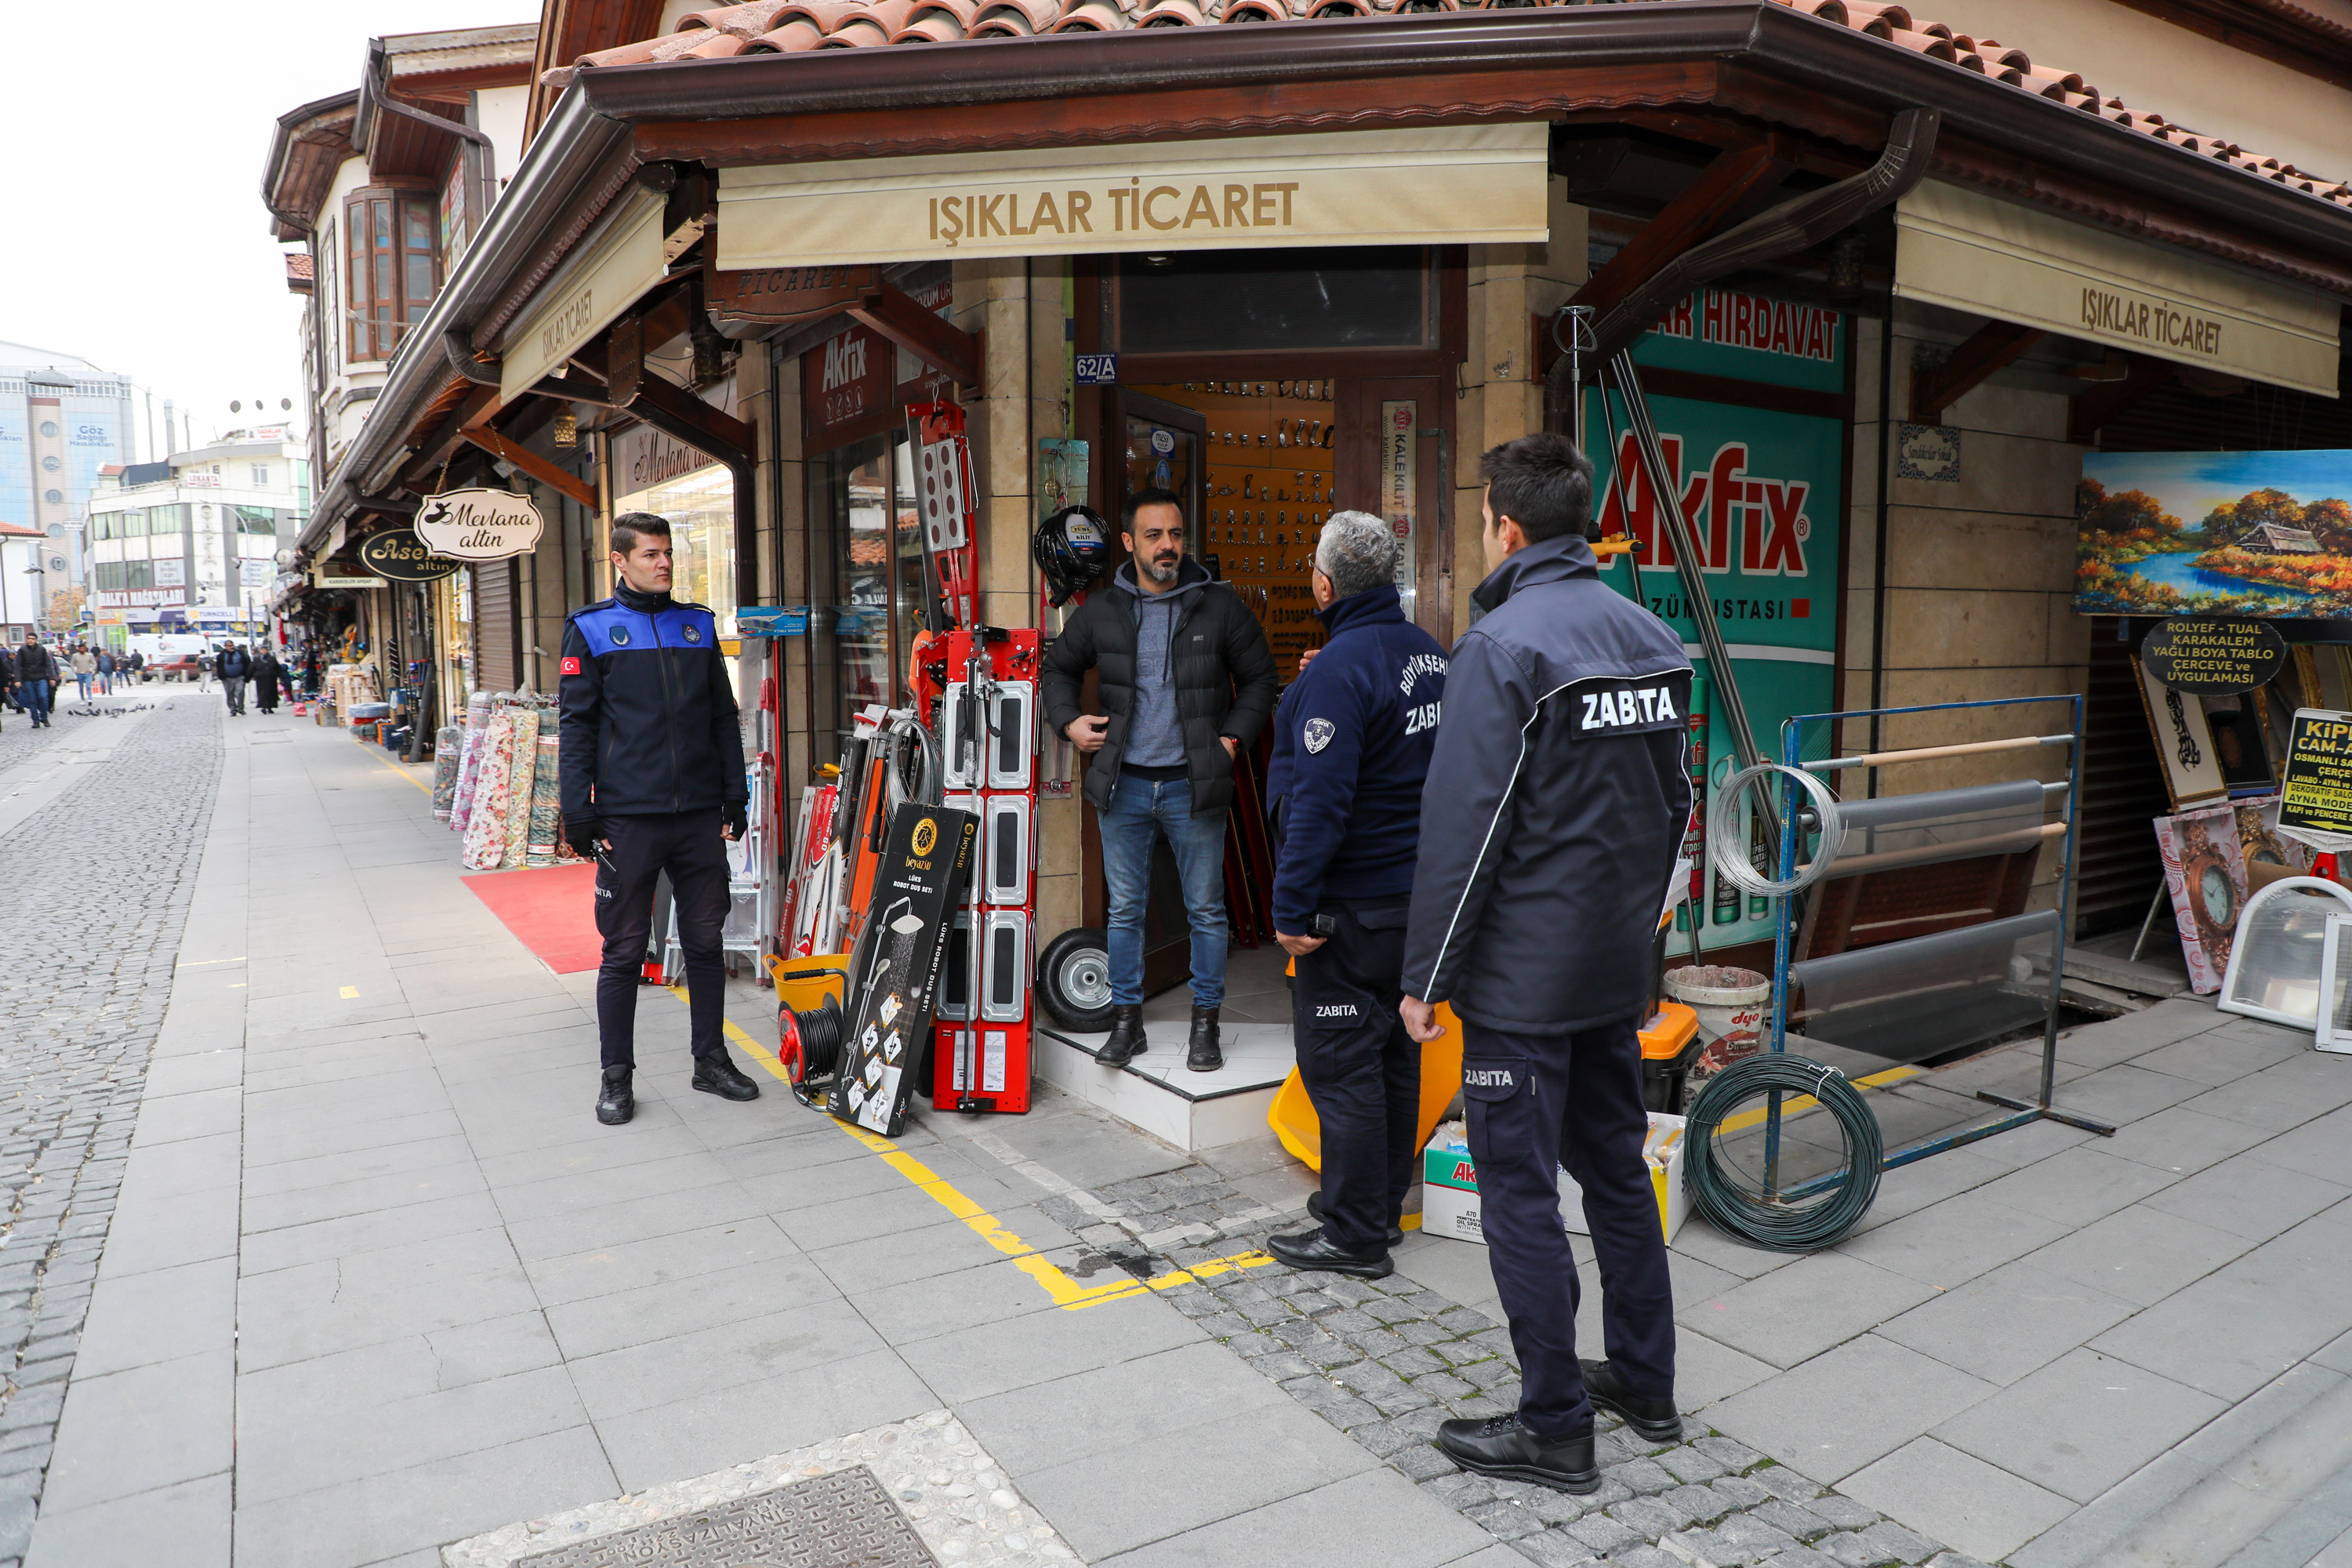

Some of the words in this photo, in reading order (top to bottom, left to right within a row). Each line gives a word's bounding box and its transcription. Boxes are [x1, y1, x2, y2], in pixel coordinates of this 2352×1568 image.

[929, 191, 1092, 247] IŞIKLAR
[1108, 177, 1299, 232] TİCARET
[1702, 289, 1839, 362] HIRDAVAT
[2081, 287, 2150, 339] IŞIKLAR
[2154, 292, 2222, 356] TİCARET
[822, 331, 866, 393] Akfix
[1076, 358, 1116, 376] 62/A
[79, 425, 104, 435] Göz
[1395, 434, 1406, 471] KALE
[1596, 428, 1810, 577] Akfix
[447, 503, 535, 528] Mevlana
[459, 529, 506, 548] altın
[416, 561, 450, 571] altın
[2167, 622, 2216, 633] ROLYEF
[2227, 624, 2262, 634] TUAL
[2172, 635, 2254, 646] KARAKALEM
[2152, 645, 2189, 658] YAĞLI
[2192, 648, 2227, 659] BOYA
[2230, 648, 2274, 660] TABLO
[2235, 662, 2251, 672] ve
[2167, 671, 2254, 684] UYGULAMASI
[1581, 685, 1678, 731] ZABITA
[1405, 700, 1441, 735] ZABI
[2306, 720, 2352, 741] KiP
[2294, 753, 2338, 766] OSMANLI
[2292, 774, 2318, 785] LAVABO
[2322, 778, 2341, 788] AYNA
[2288, 793, 2318, 805] AYNA
[2286, 804, 2303, 815] KAPI
[2314, 808, 2348, 821] PENCERE
[956, 837, 971, 869] beyazsu
[905, 855, 931, 870] beyazsu
[893, 880, 910, 889] ROBOT
[910, 884, 920, 892] DUŞ
[908, 874, 921, 883] LÜKS
[938, 922, 948, 944] LÜKS
[931, 946, 942, 973] ROBOT
[925, 975, 935, 992] DUŞ
[1316, 1004, 1358, 1018] ZABITA
[1731, 1011, 1759, 1027] dyo
[1465, 1069, 1513, 1087] ZABITA
